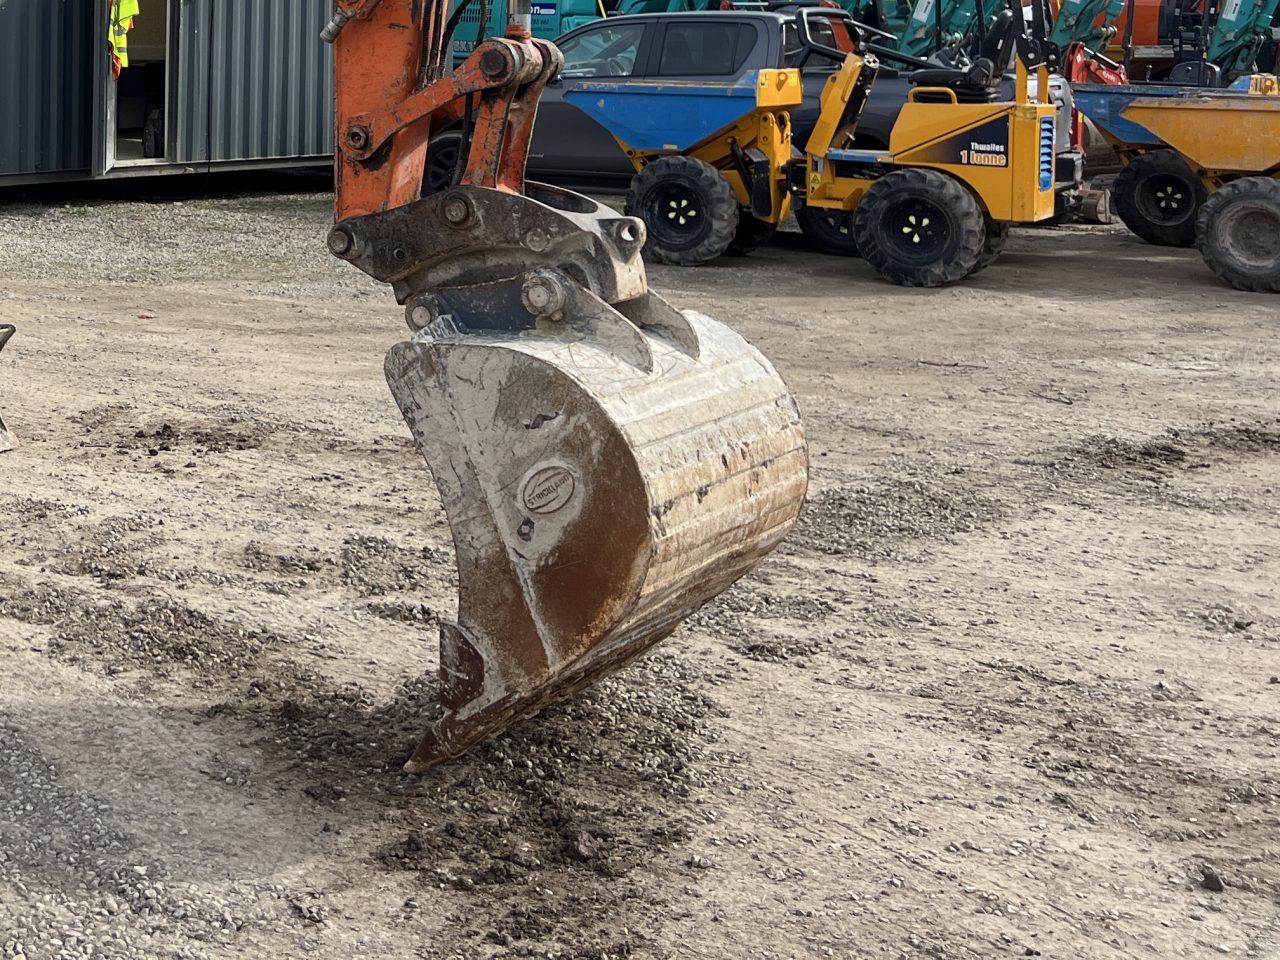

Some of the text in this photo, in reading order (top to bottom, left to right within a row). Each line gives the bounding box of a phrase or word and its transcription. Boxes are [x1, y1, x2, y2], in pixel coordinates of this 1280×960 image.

[971, 142, 1005, 152] Thwaites
[960, 150, 1007, 166] 1 tonne
